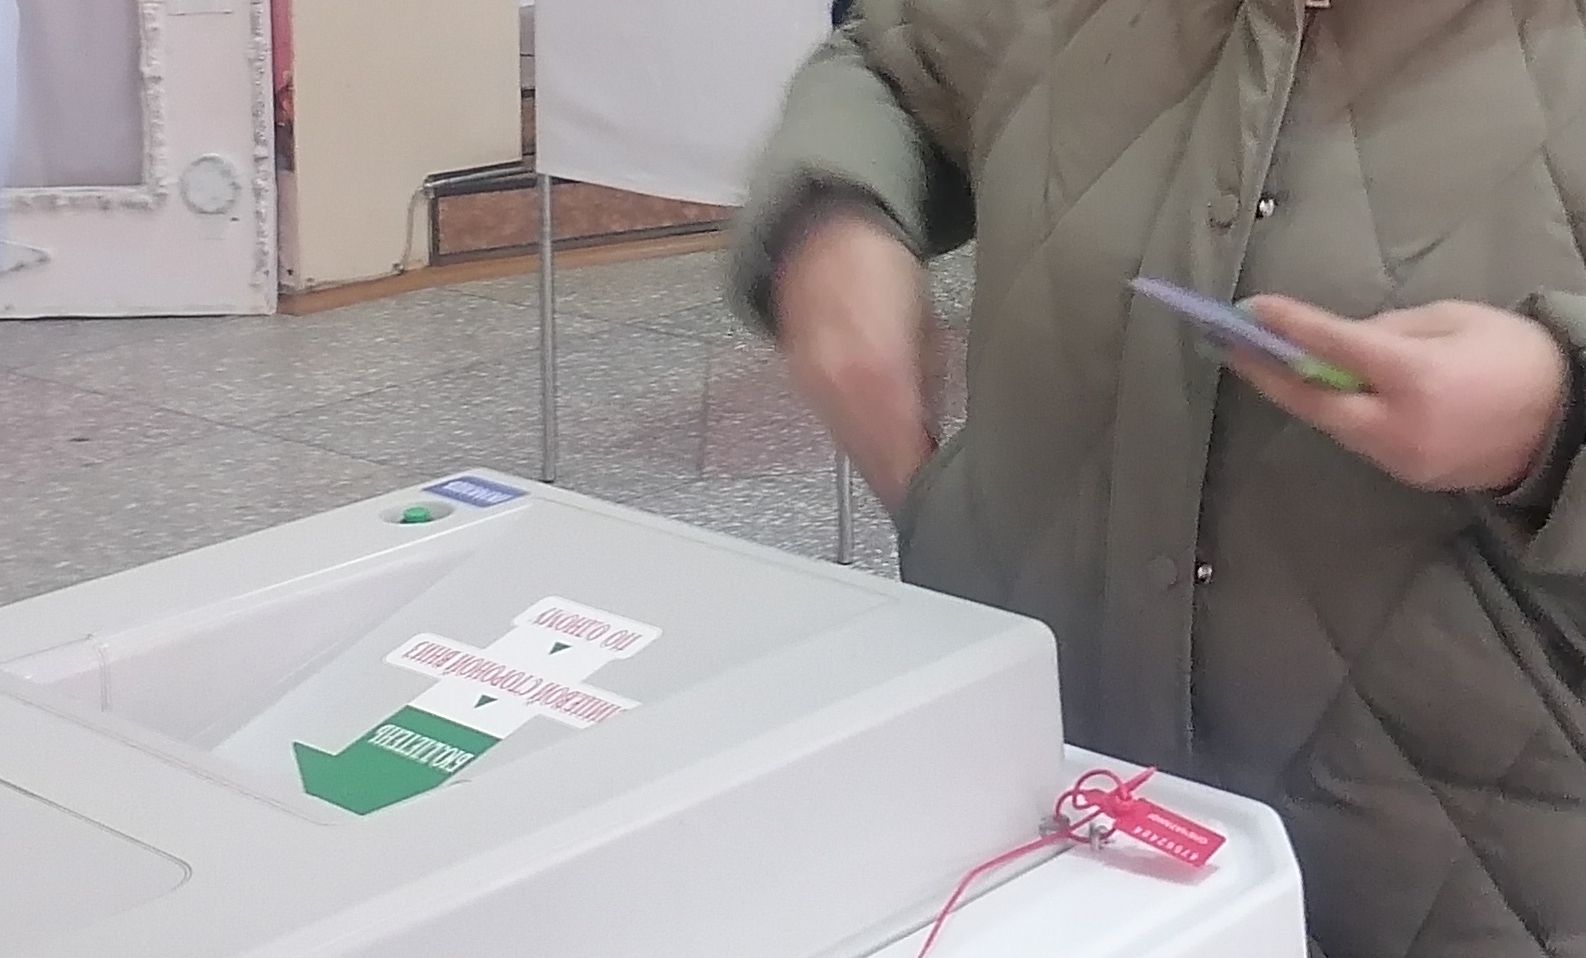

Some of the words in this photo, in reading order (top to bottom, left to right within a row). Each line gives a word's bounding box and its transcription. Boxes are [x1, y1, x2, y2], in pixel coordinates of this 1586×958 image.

[535, 608, 610, 641] ОДНОМУ
[602, 628, 643, 653] ПО
[404, 641, 453, 668] ВНИЗ
[442, 655, 541, 697] СТОРОНОЙ
[368, 723, 475, 773] БЮЛЛЕТЕНЬ
